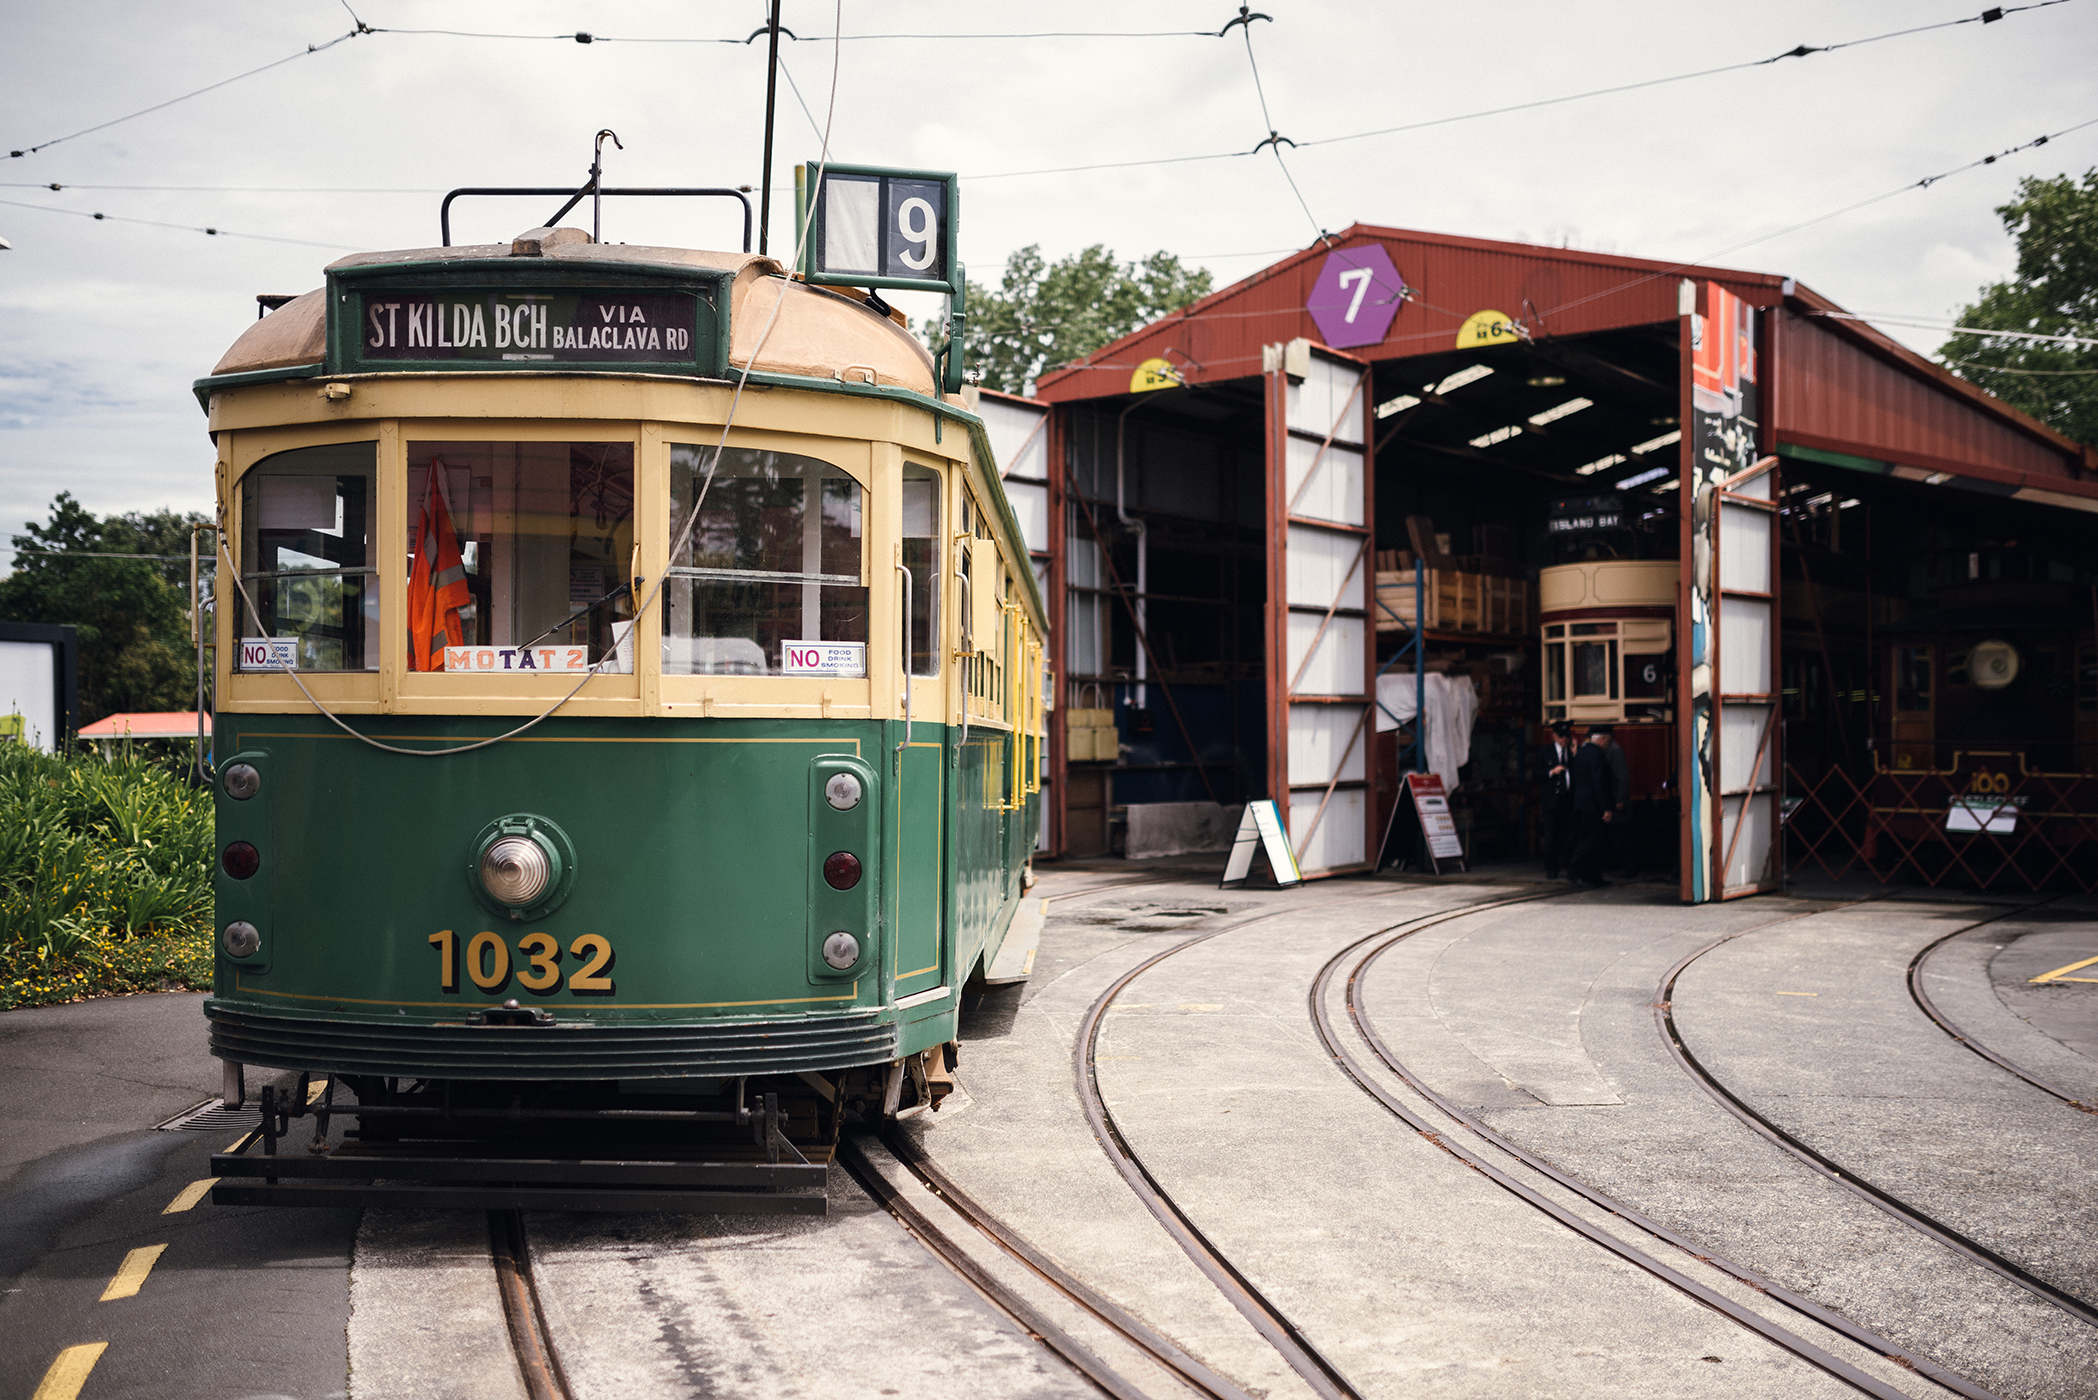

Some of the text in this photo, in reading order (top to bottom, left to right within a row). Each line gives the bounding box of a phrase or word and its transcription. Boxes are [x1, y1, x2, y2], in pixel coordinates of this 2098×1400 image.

[898, 197, 938, 271] 9
[1339, 267, 1374, 324] 7
[599, 305, 646, 323] VIA
[369, 303, 547, 348] ST KILDA BCH
[553, 326, 689, 350] BALACLAVA RD
[1551, 514, 1619, 531] ISLAND BAY
[245, 646, 266, 664] NO
[791, 650, 820, 667] NO
[1643, 664, 1656, 683] 6
[428, 930, 617, 997] 1032
